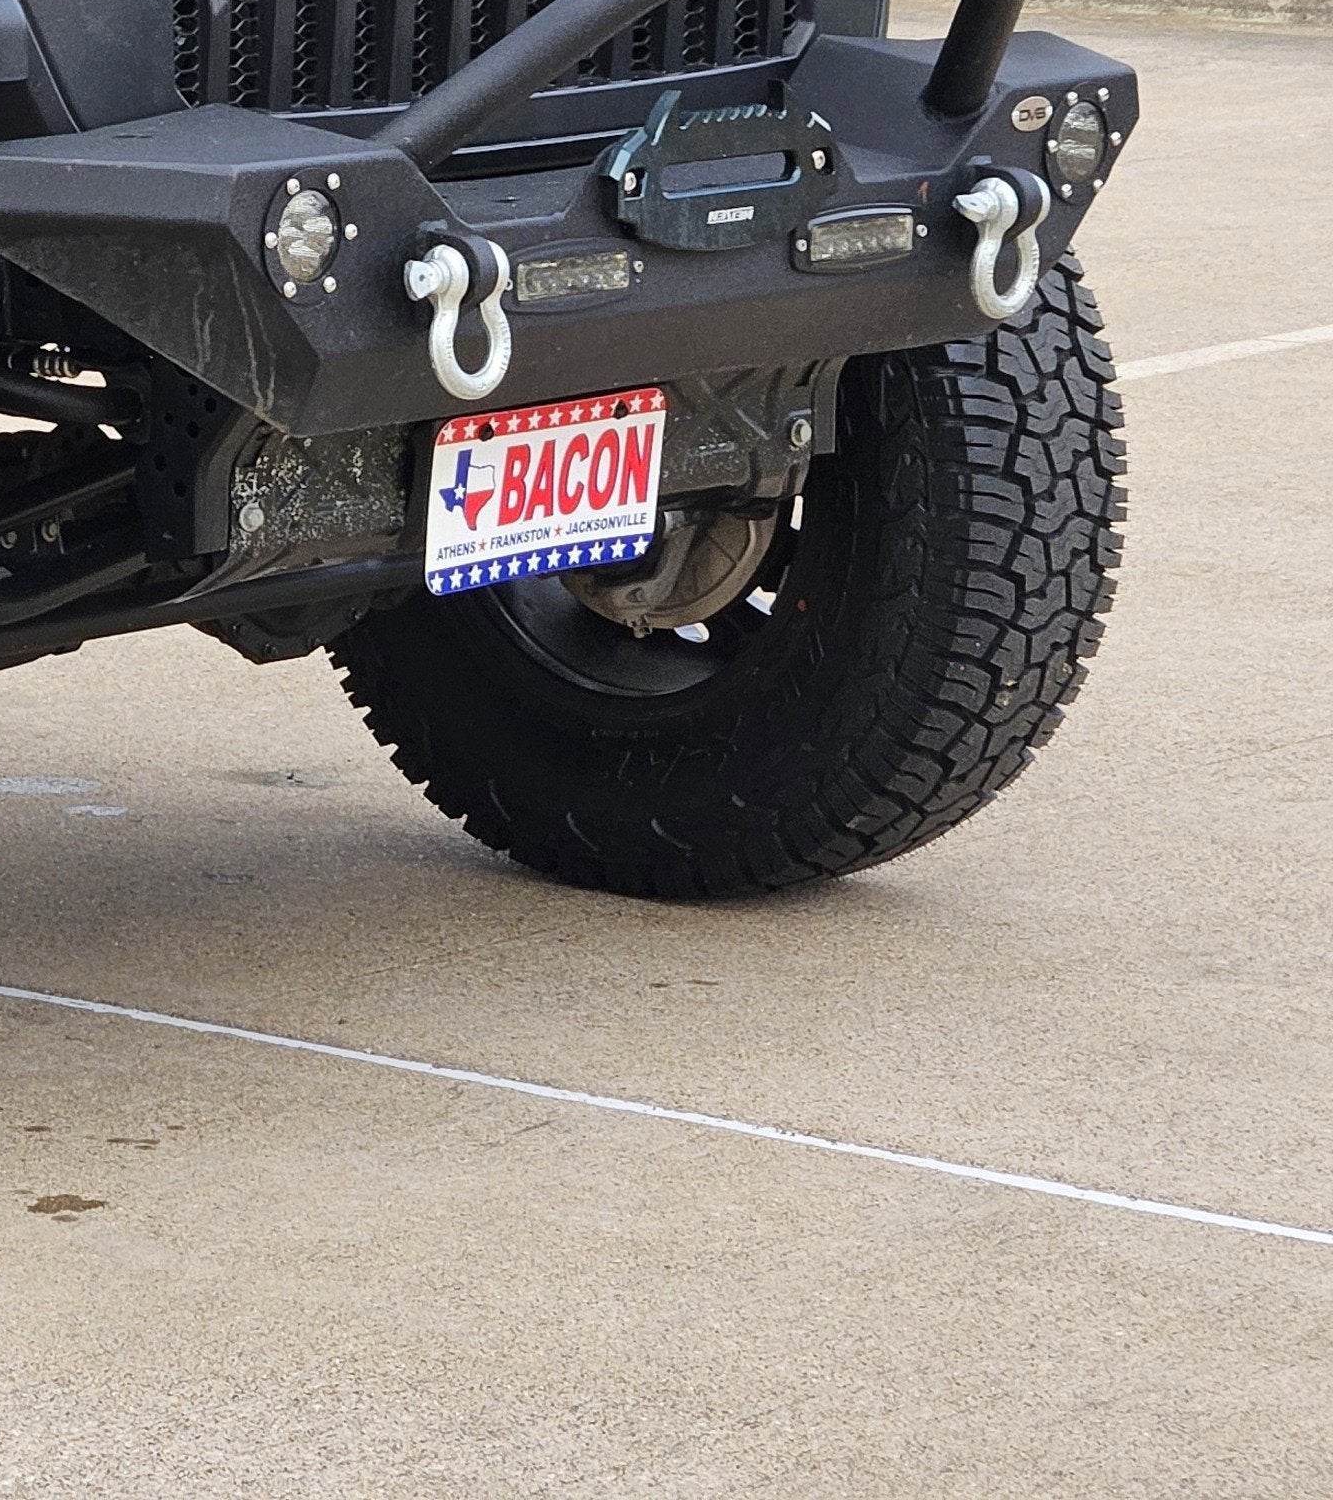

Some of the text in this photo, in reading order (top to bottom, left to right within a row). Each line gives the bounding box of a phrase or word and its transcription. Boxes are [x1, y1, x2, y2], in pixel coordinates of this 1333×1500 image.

[497, 423, 655, 526] BACON
[437, 512, 648, 561] ATHENS FRANKSTON JACKSONVILLE
